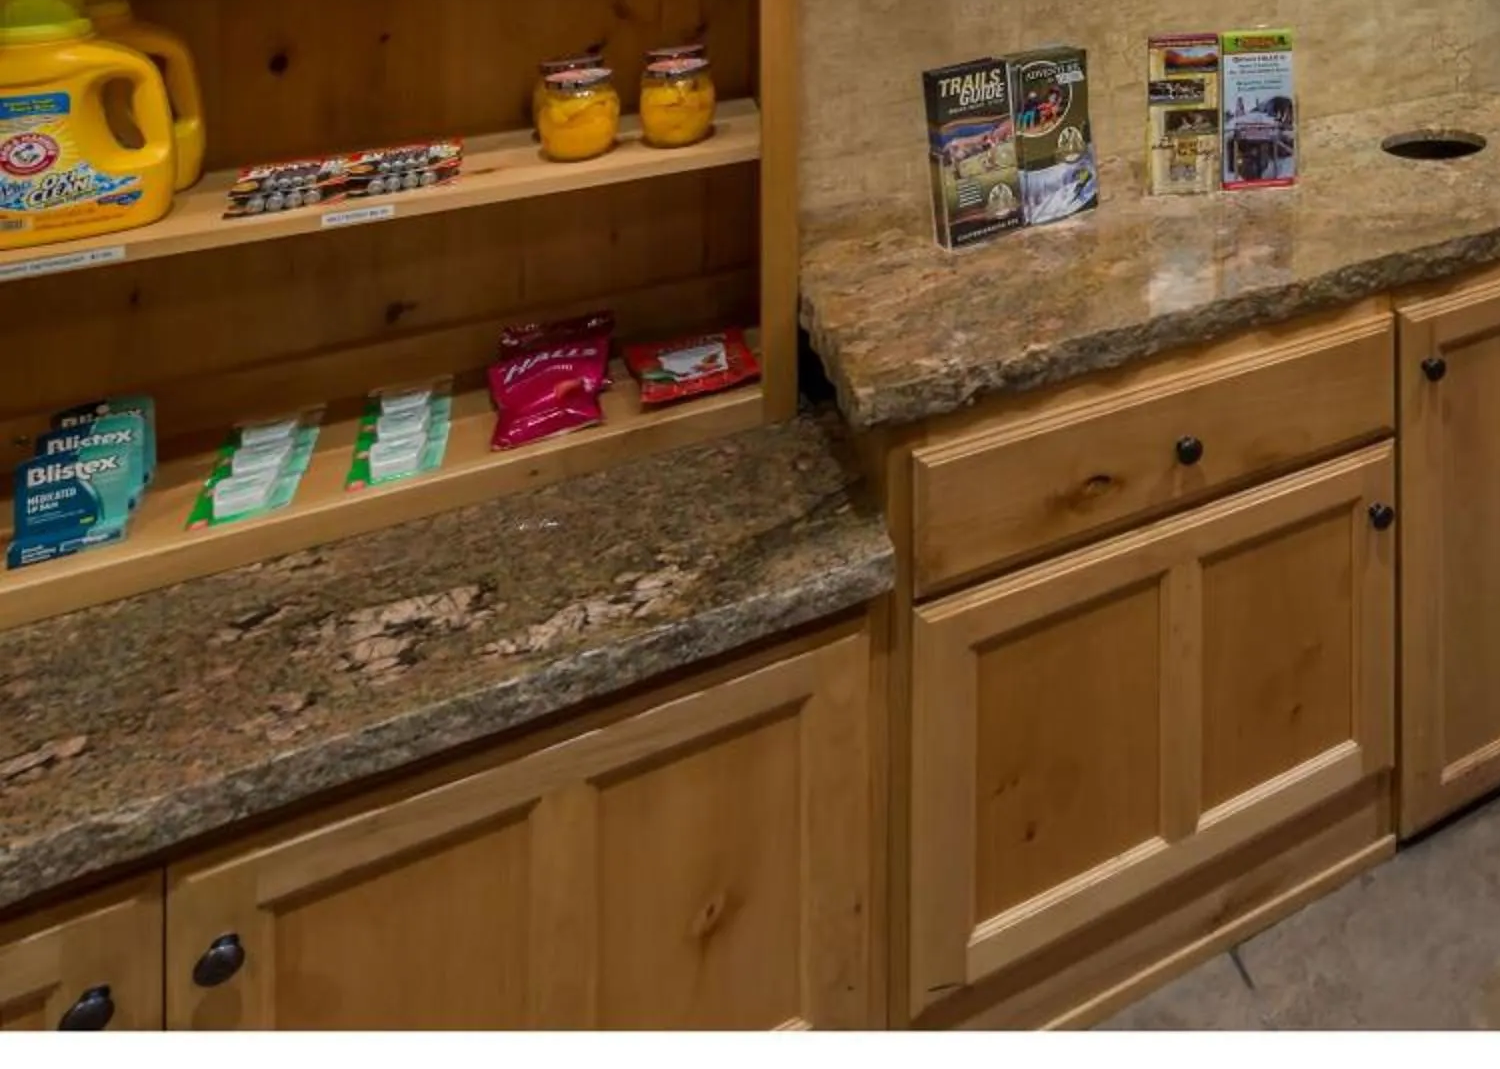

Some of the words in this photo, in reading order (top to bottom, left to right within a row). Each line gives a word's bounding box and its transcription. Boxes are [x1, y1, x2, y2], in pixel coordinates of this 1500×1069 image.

[938, 68, 1001, 98] TRAILS
[960, 81, 1005, 106] GUIDE
[27, 455, 118, 488] Blistex
[27, 486, 77, 506] MEDICATED
